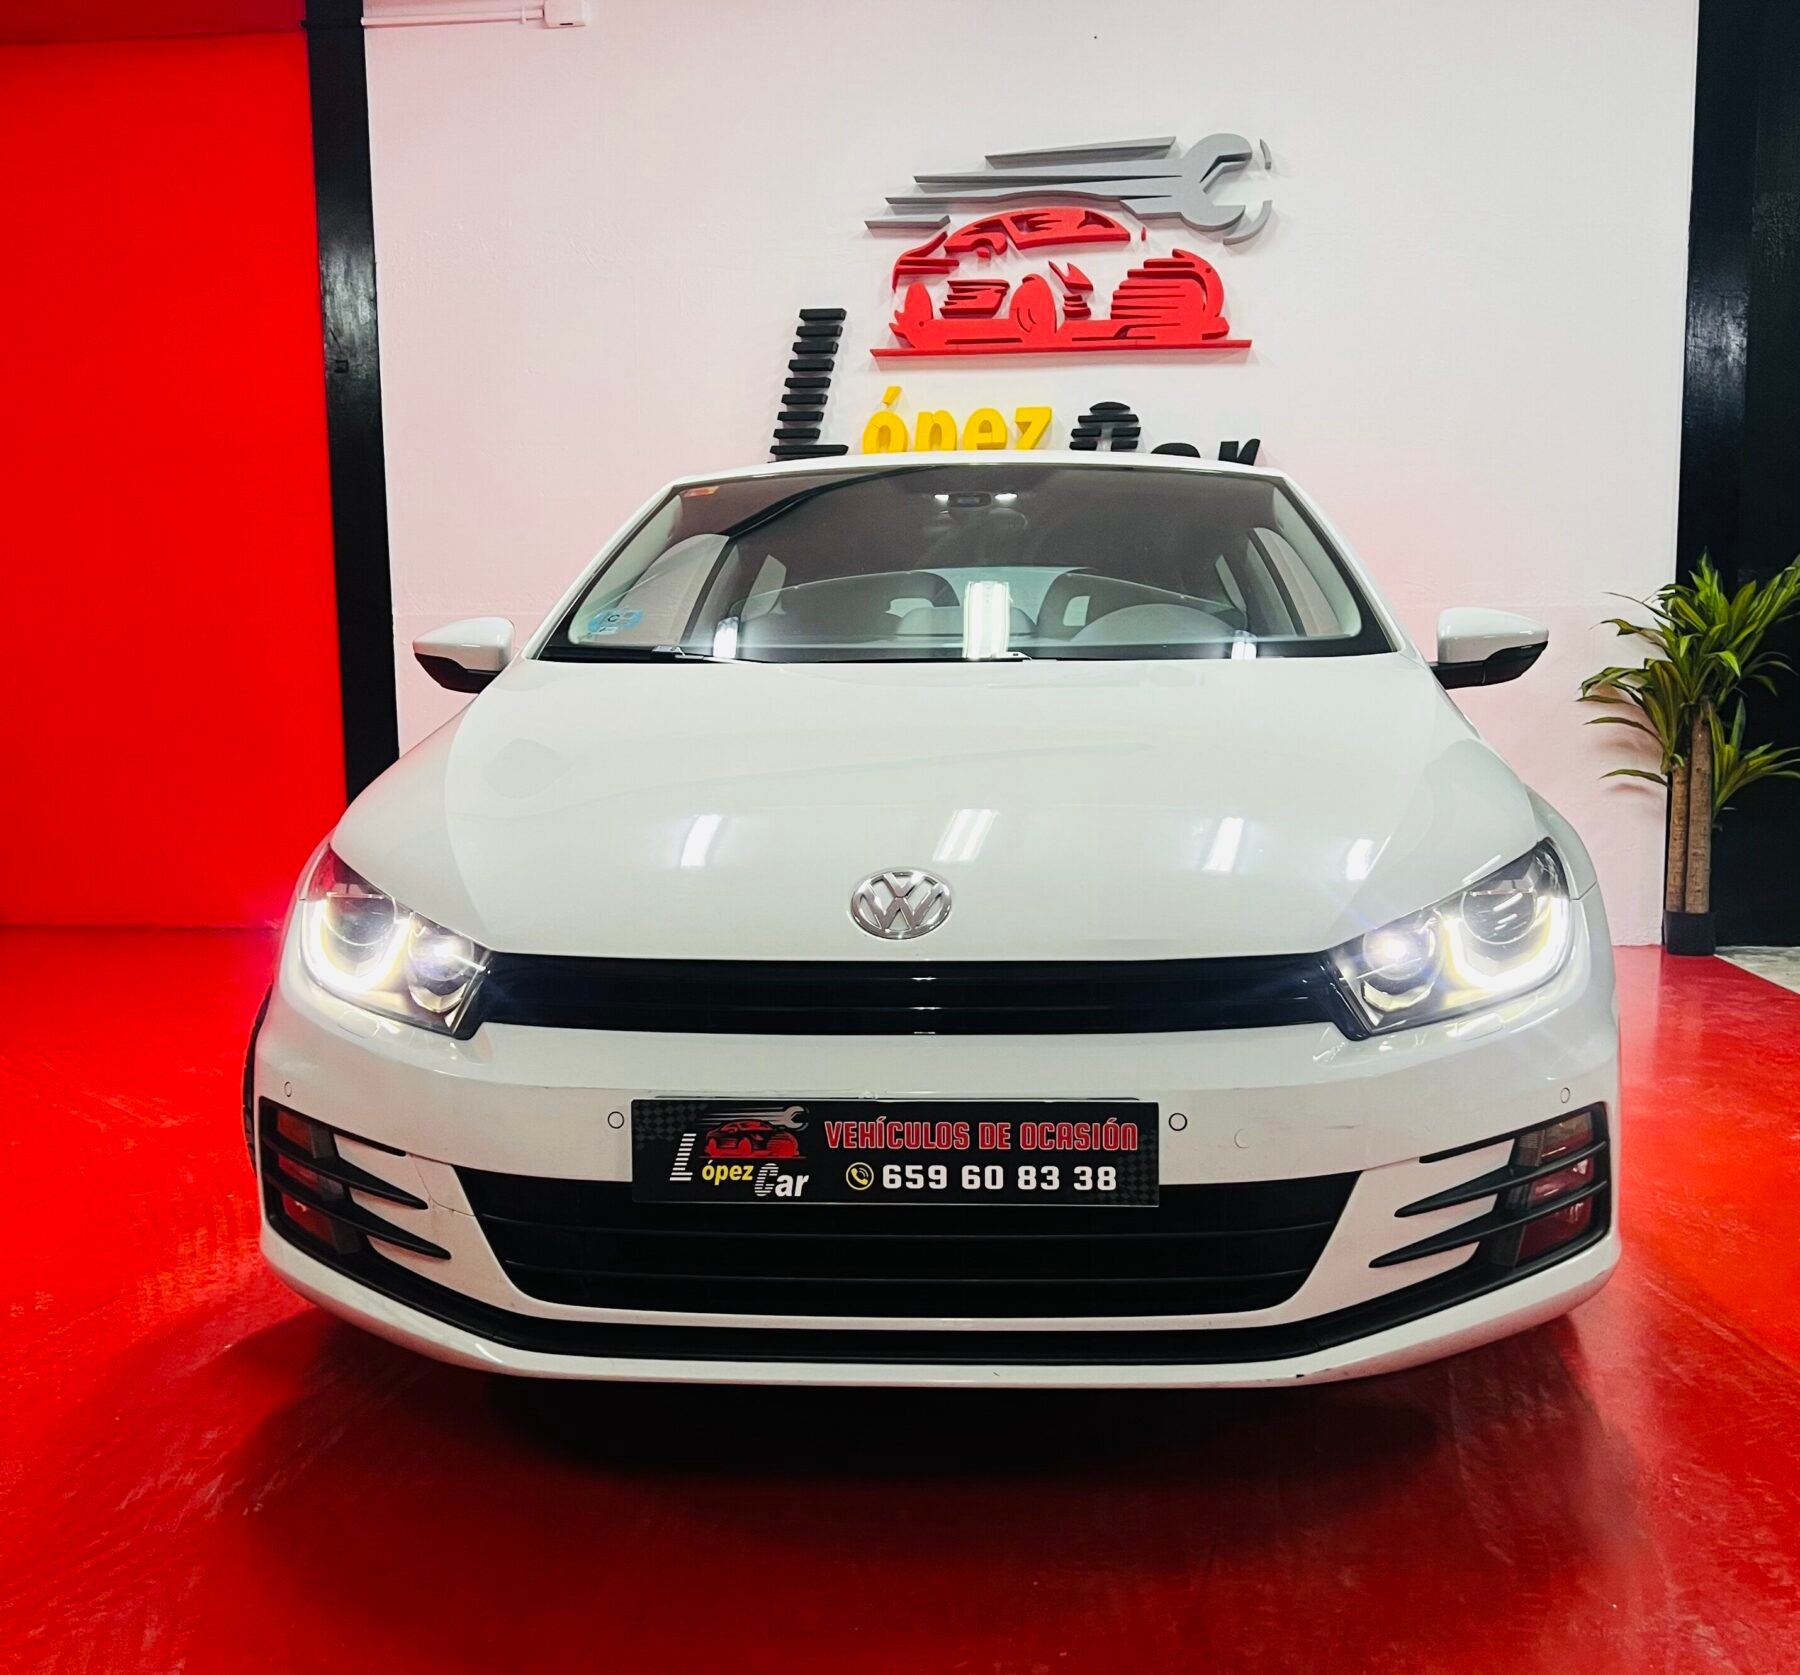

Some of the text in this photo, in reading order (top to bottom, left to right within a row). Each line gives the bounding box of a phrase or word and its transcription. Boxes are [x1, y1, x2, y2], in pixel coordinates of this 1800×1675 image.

[824, 1115, 1139, 1151] VEHÍCULOS DE OCASIÓN
[669, 1133, 810, 1197] López Car
[882, 1164, 1117, 1191] 659 60 83 38
